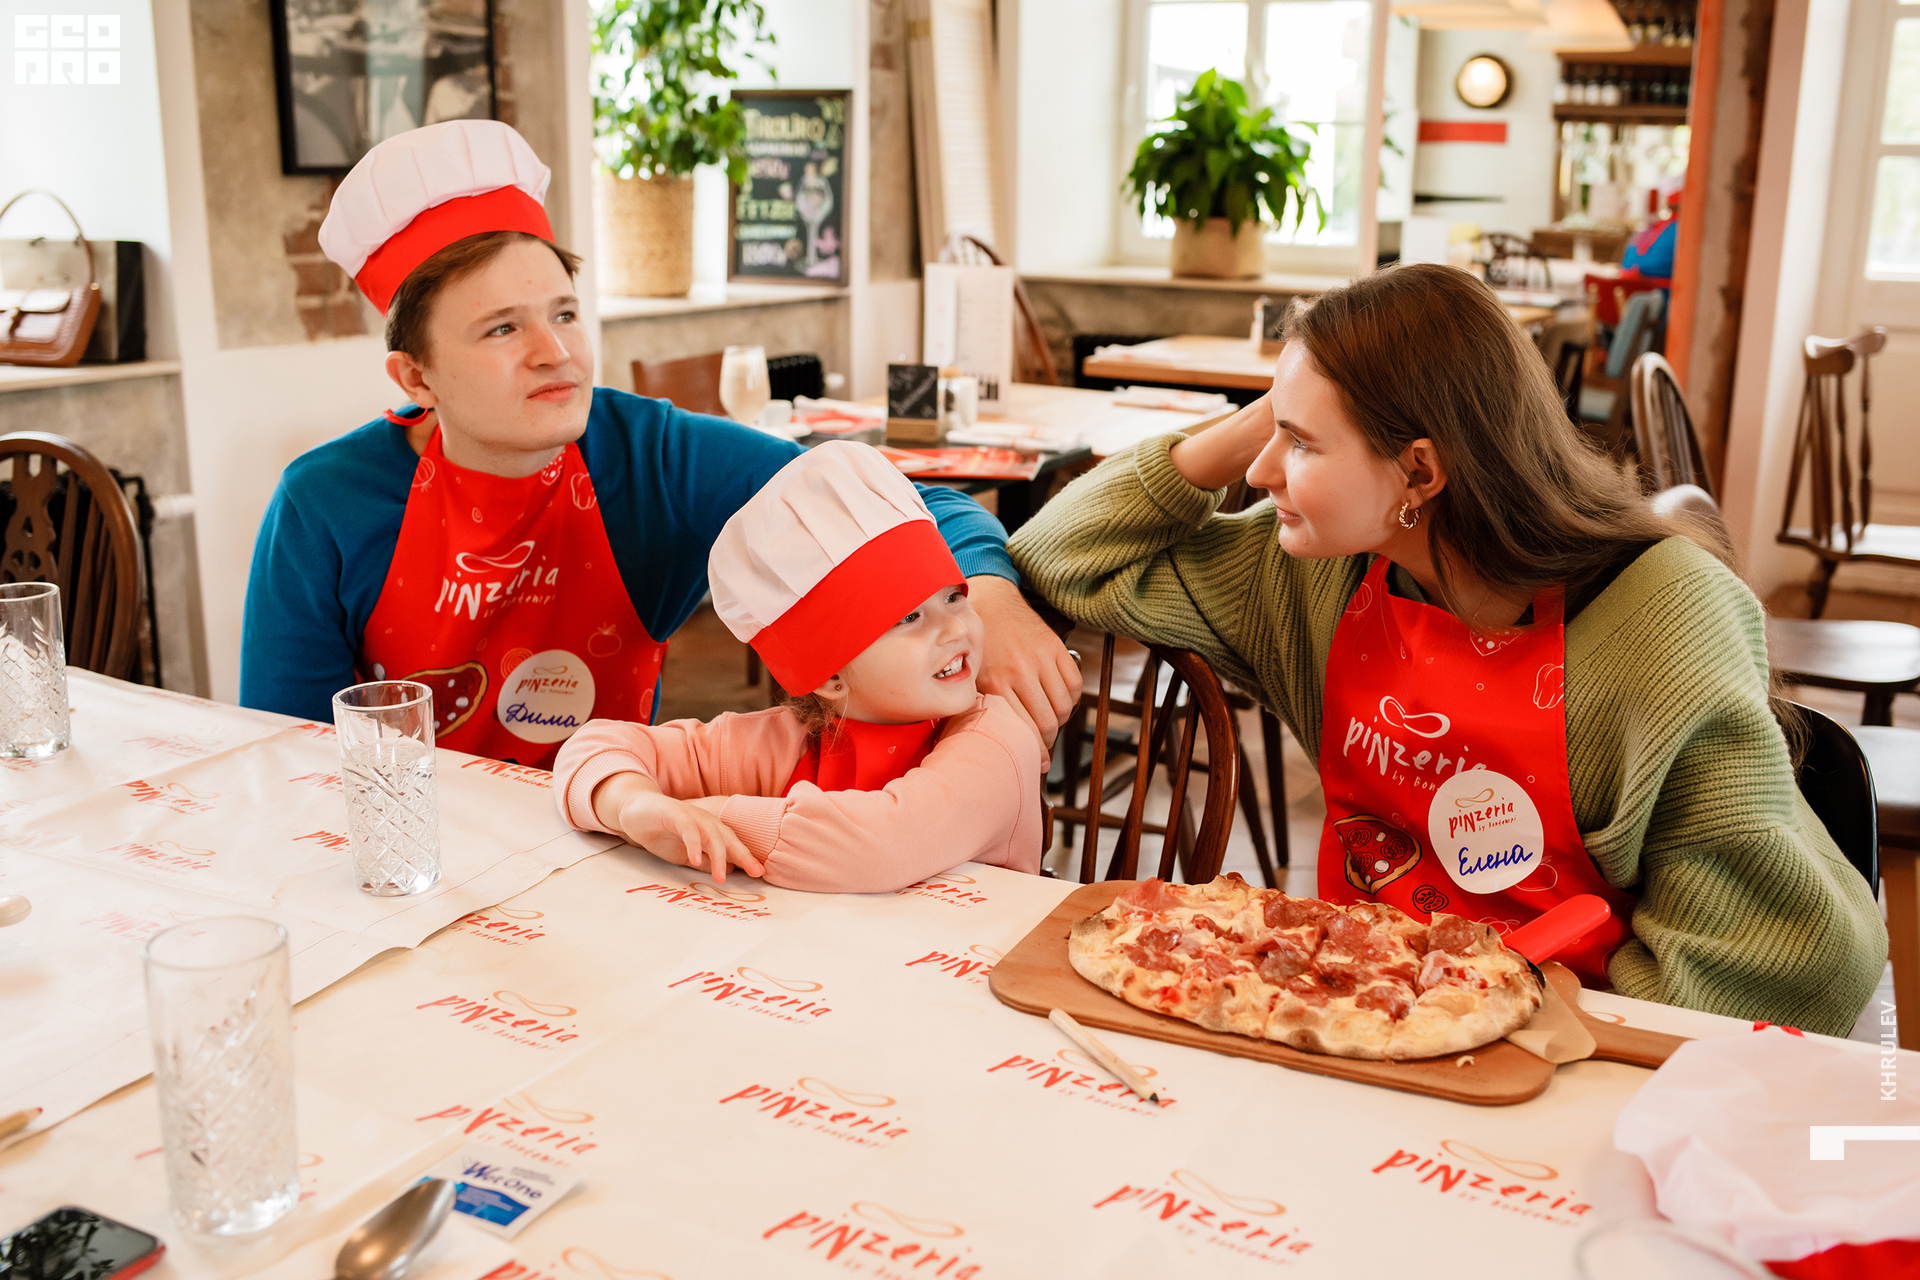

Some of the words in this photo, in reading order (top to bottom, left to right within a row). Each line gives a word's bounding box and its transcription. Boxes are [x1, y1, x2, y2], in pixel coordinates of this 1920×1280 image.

[505, 702, 580, 728] Дима
[1392, 770, 1405, 785] by
[1458, 844, 1534, 877] Елена
